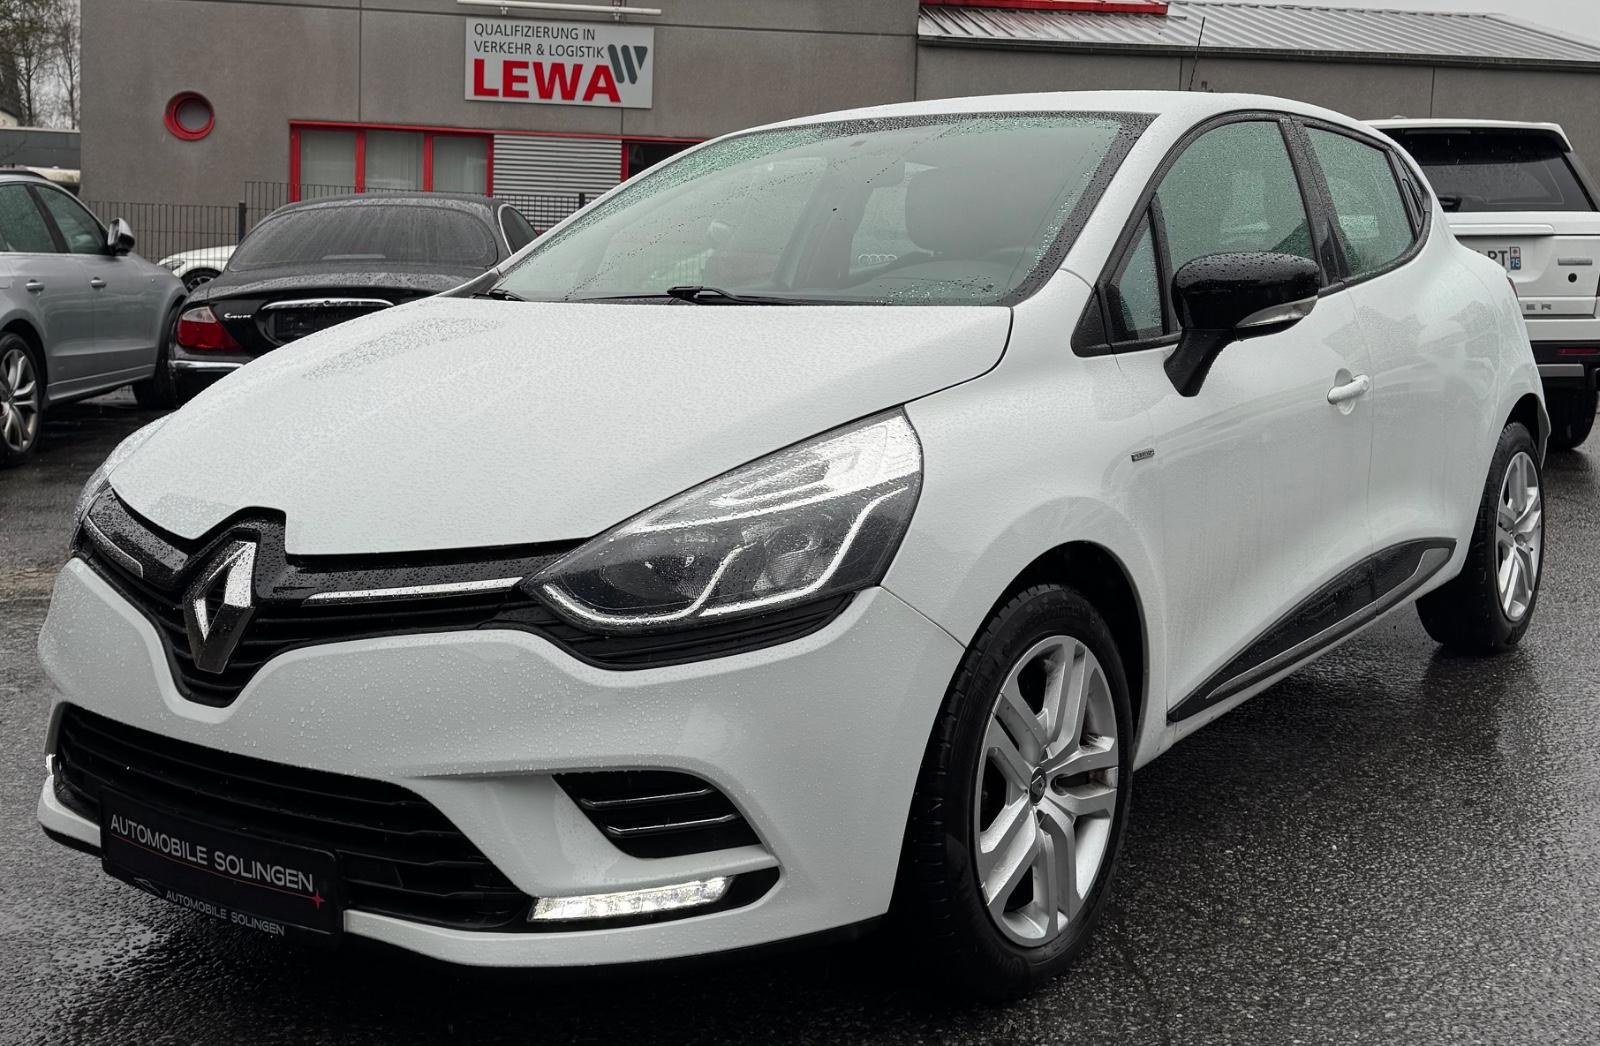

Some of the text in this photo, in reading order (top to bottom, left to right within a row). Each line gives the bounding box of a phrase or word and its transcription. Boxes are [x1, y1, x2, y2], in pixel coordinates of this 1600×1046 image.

[474, 23, 595, 41] QUALIFIZIERUNG IN
[474, 40, 604, 59] VERKEHR & LOGISTIK
[473, 58, 621, 104] LEWA
[110, 813, 314, 893] AUTOMOBILE SOLINGEN
[165, 890, 285, 937] AUTOMOBILE SOLINGEN
